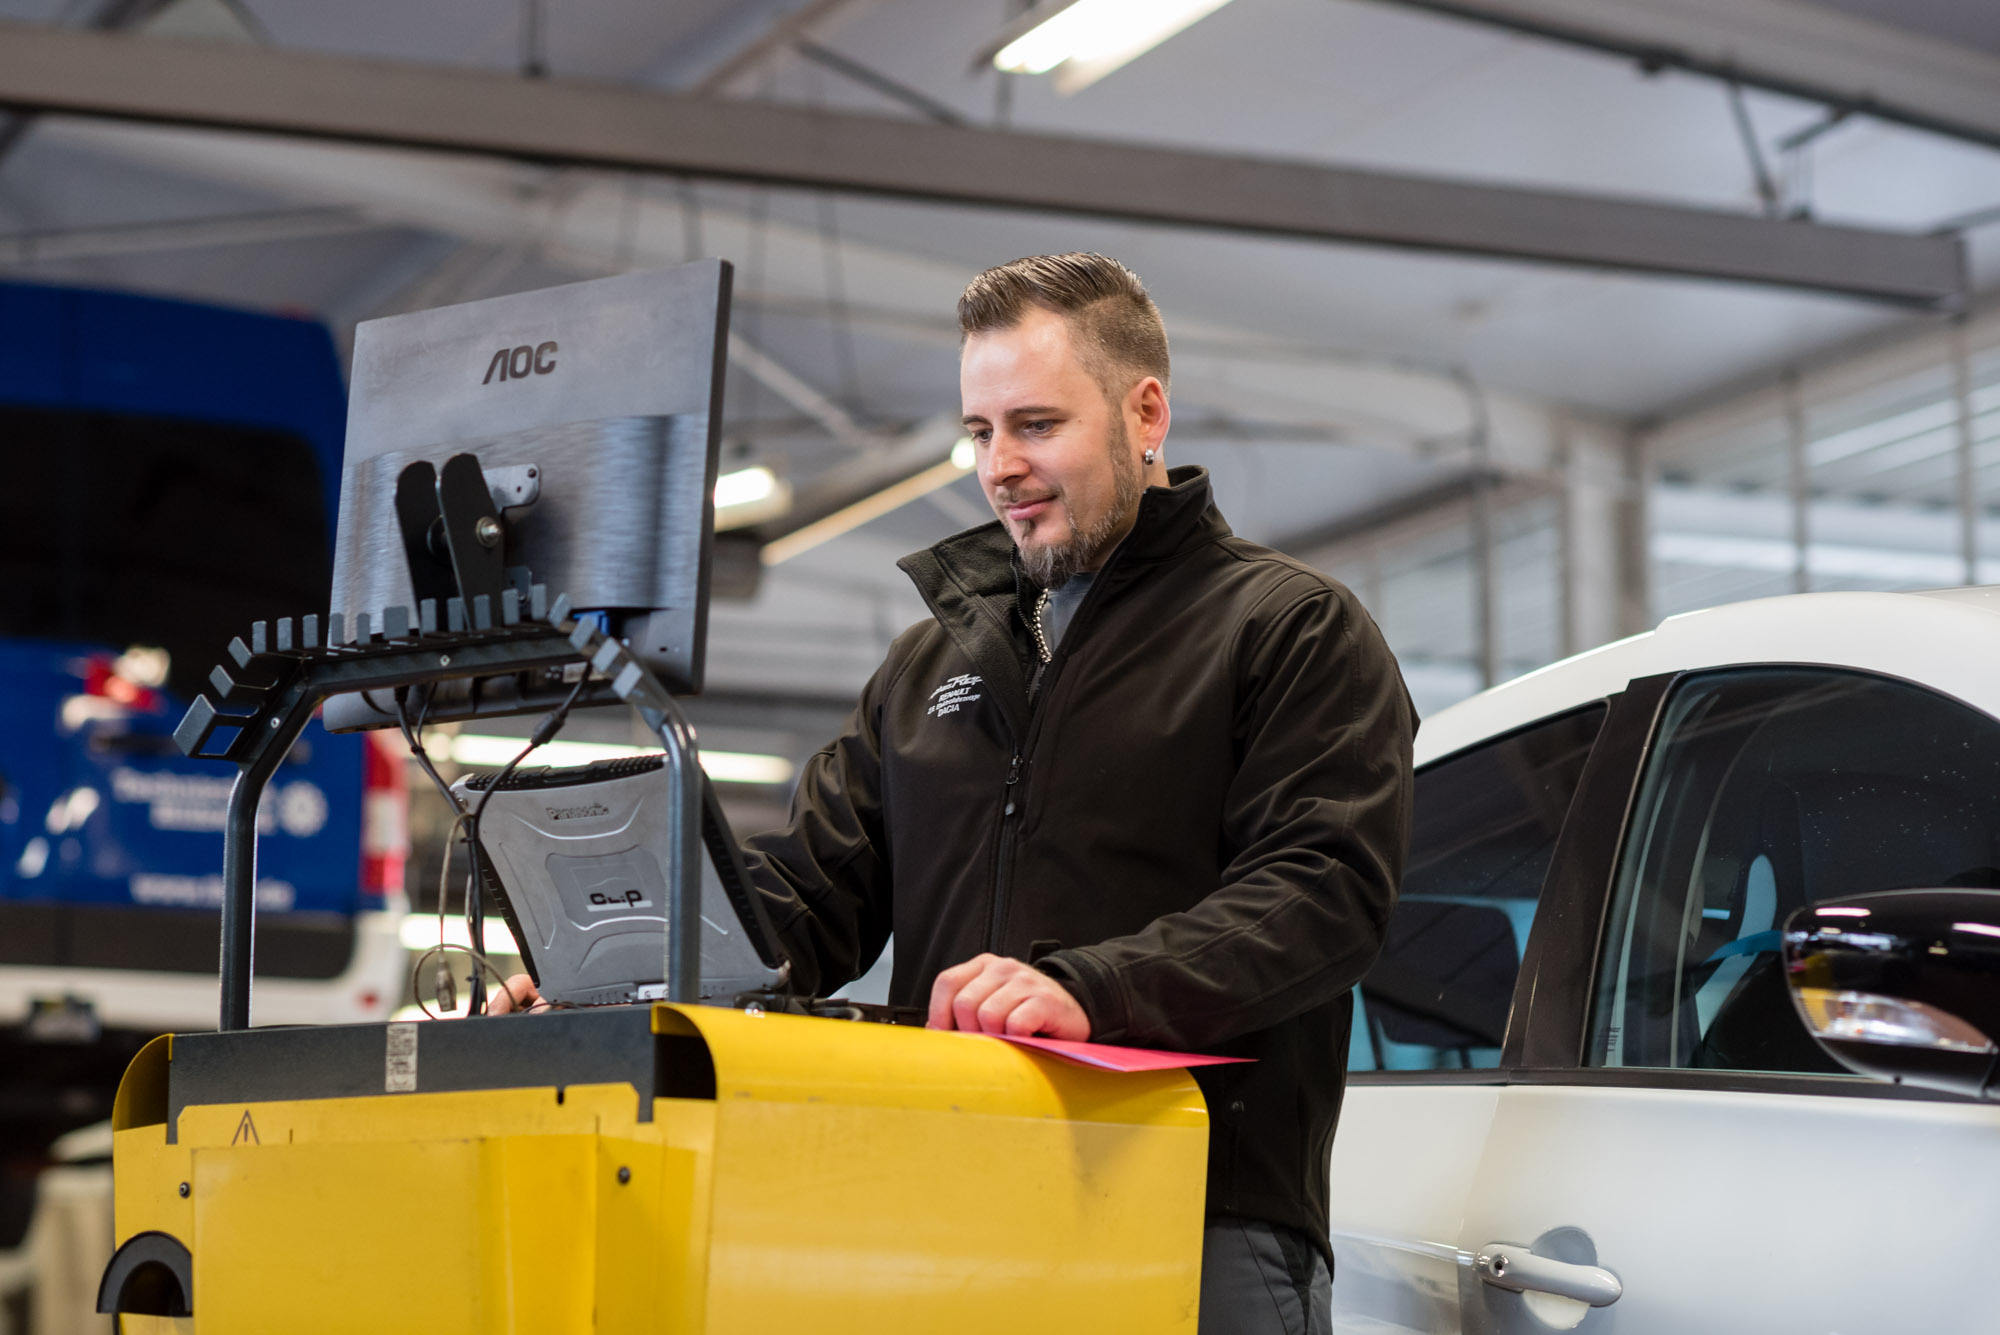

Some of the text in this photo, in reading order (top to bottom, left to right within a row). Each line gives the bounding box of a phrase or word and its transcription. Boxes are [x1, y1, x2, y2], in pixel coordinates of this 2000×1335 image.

[482, 341, 558, 385] AOC
[939, 687, 971, 702] RENAULT
[937, 704, 960, 717] DACIA
[546, 803, 609, 820] Panasonic
